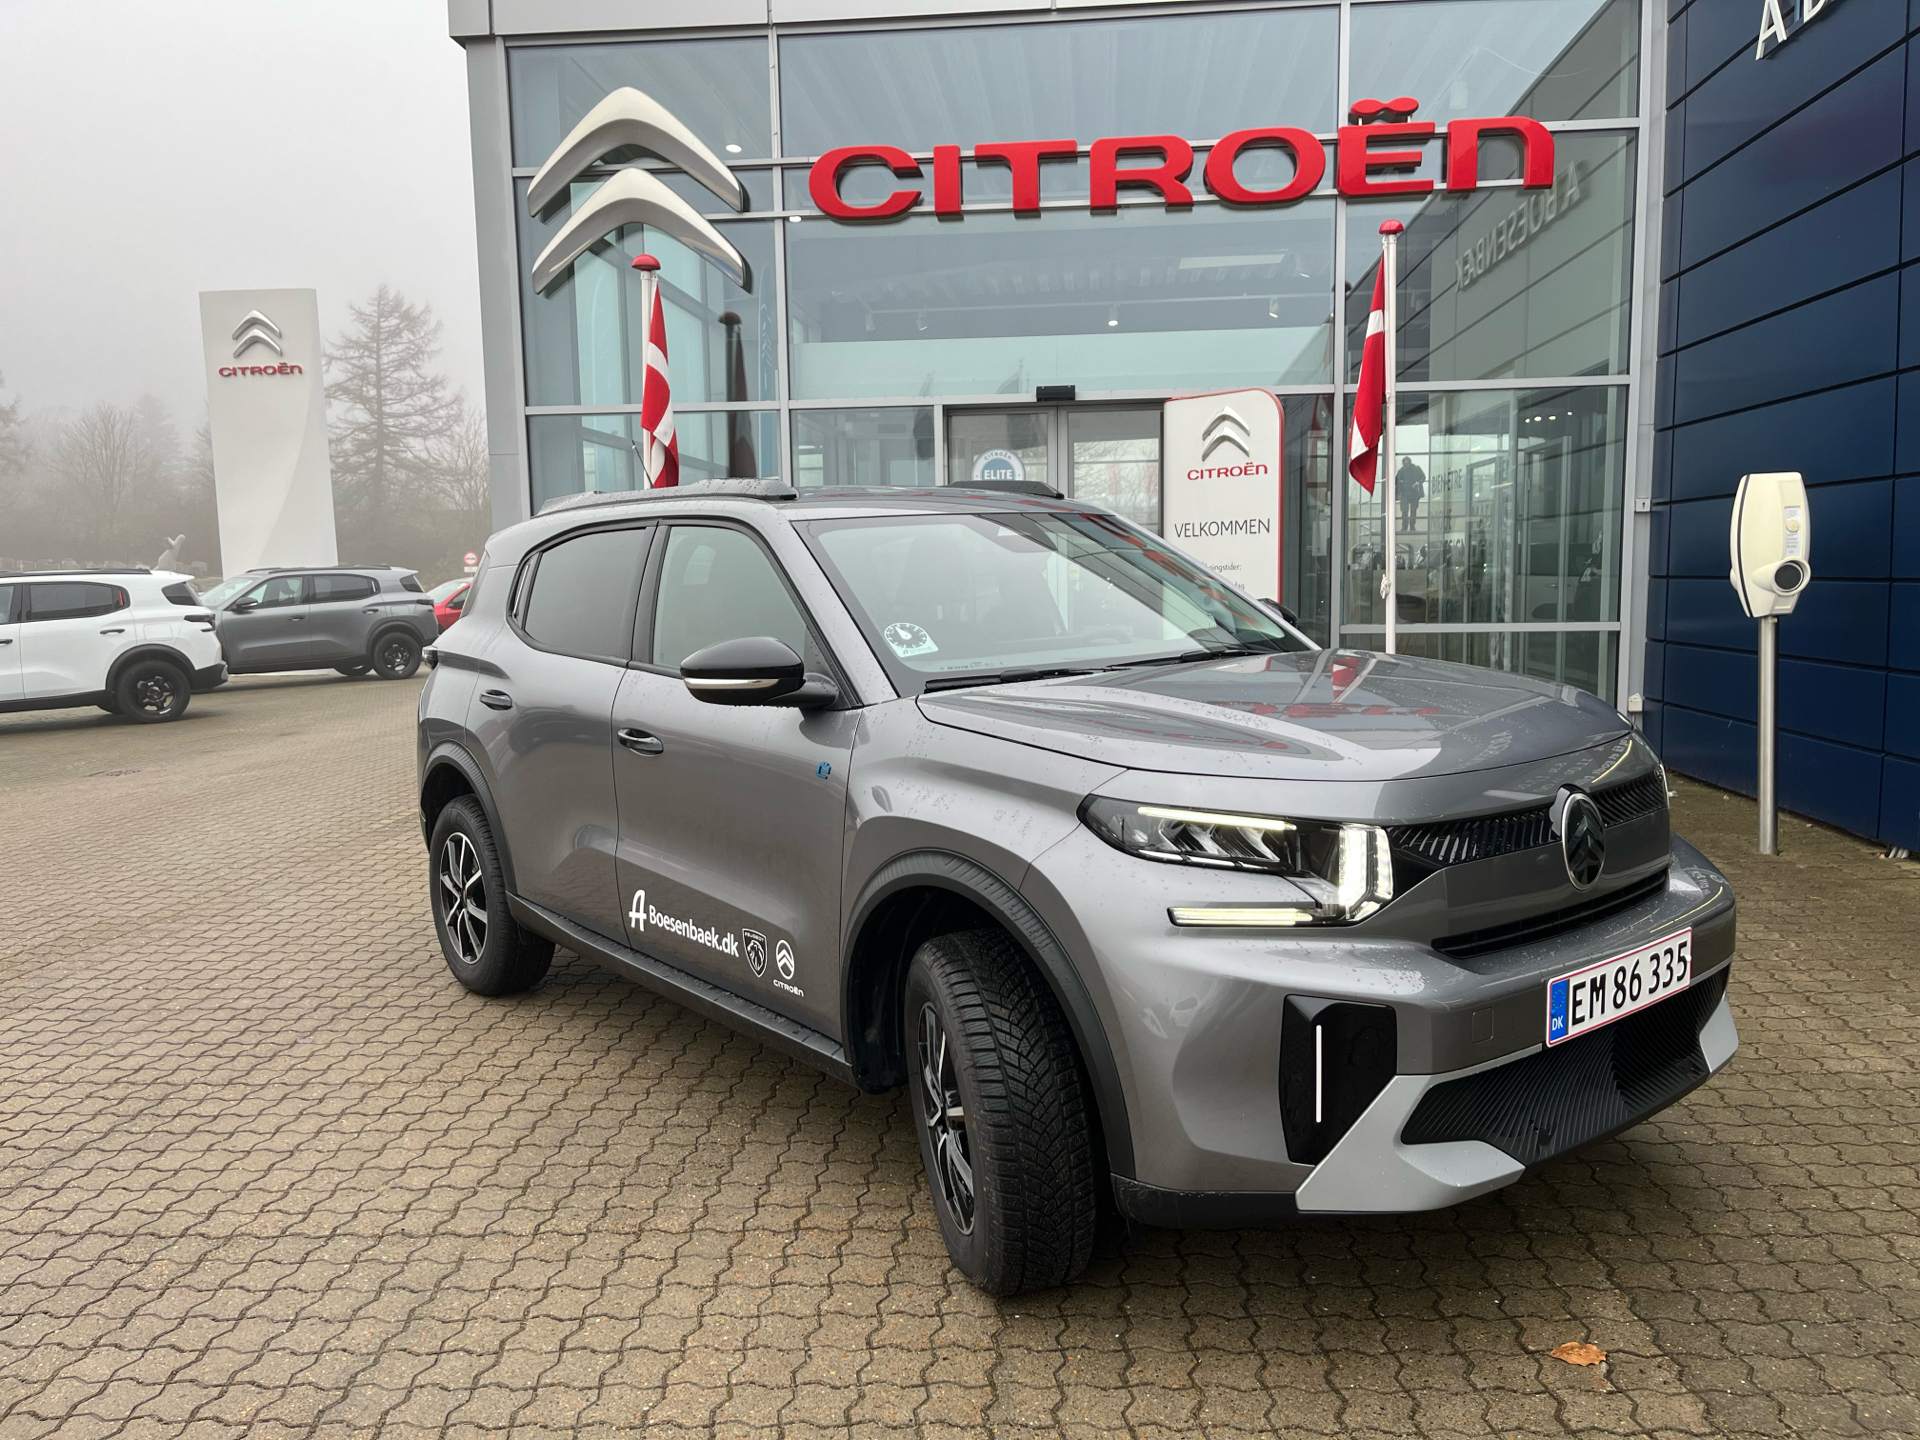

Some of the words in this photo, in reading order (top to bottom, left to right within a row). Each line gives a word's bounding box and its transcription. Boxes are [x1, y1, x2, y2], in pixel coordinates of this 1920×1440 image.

[808, 96, 1555, 221] CITROËN
[218, 362, 303, 377] CITROËN
[984, 469, 1013, 480] ELITE
[1187, 462, 1268, 480] CITROËN
[1174, 518, 1270, 538] VELKOMMEN
[1201, 561, 1241, 573] ningstider:
[649, 905, 740, 957] Boesenbaek.dk
[773, 979, 804, 997] CITROËN
[1571, 973, 1607, 1026] EM
[1612, 958, 1641, 1009] 86
[1648, 940, 1688, 994] 335
[1551, 1015, 1563, 1031] DK
